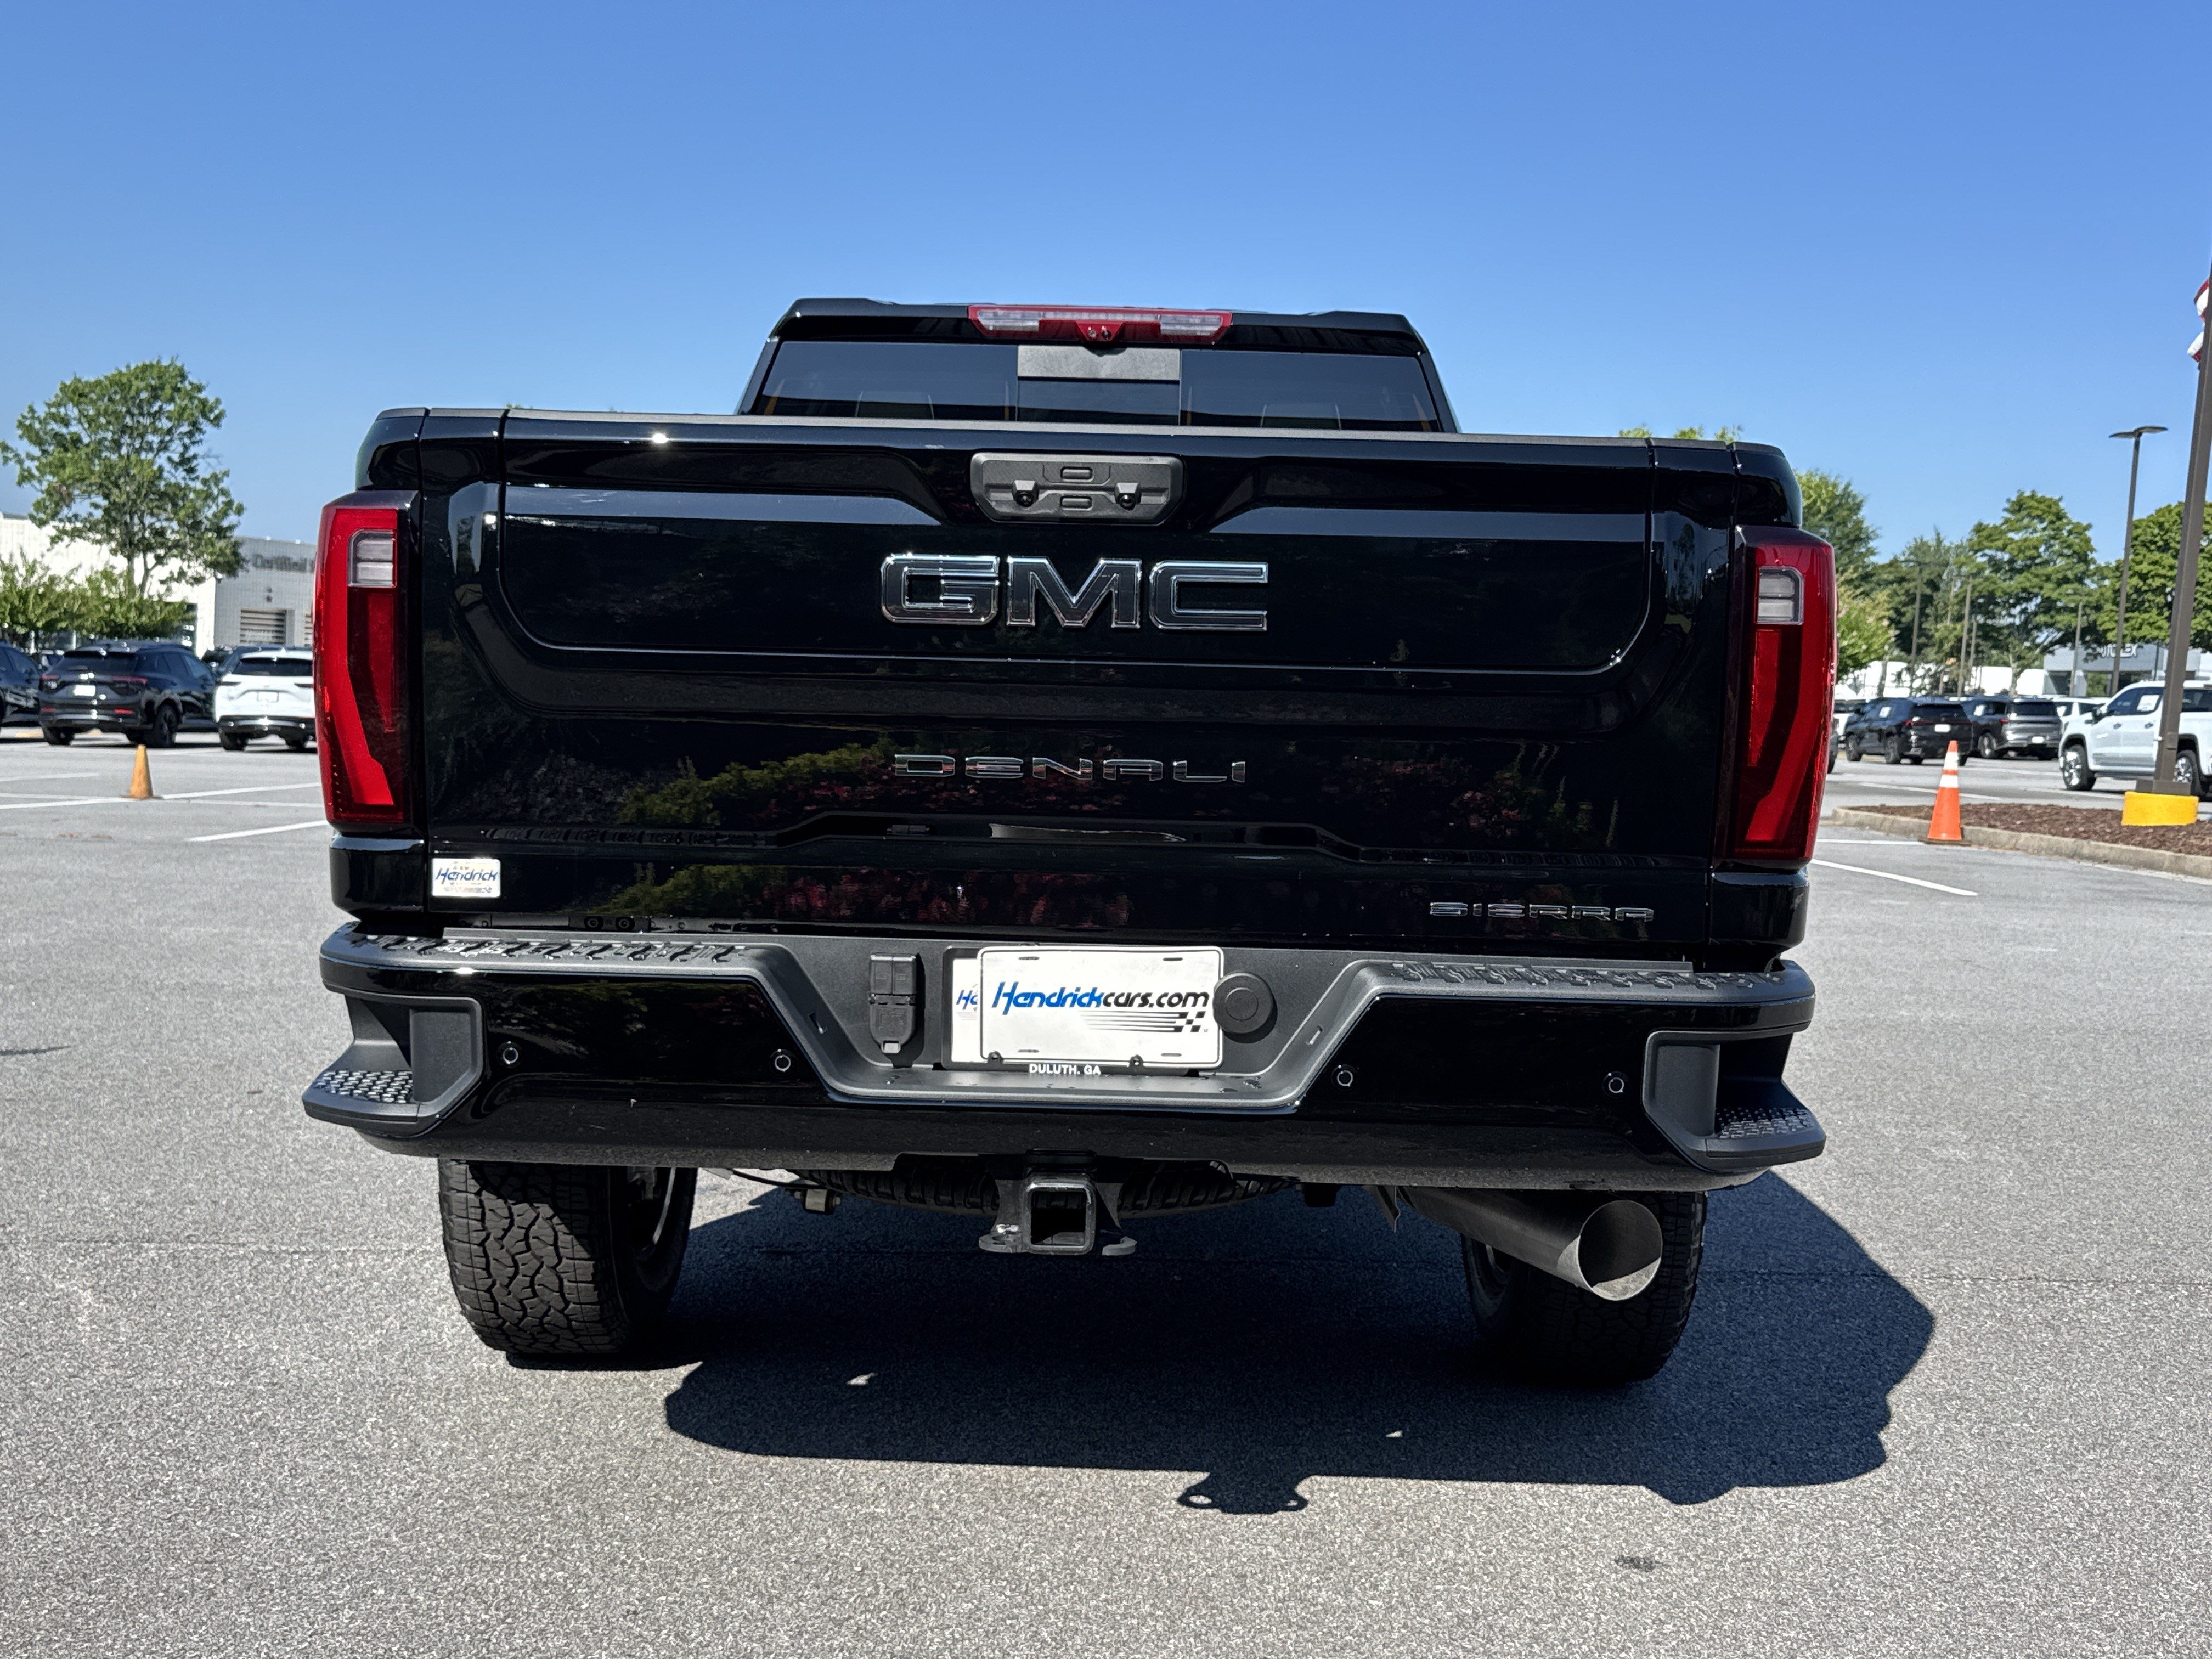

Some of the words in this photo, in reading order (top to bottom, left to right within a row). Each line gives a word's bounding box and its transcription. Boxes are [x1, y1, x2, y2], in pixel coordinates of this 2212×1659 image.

[881, 554, 1269, 631] GMC
[894, 754, 1246, 783] DENALI
[436, 867, 499, 885] Hendrick
[1430, 902, 1654, 922] SIERRA
[992, 981, 1210, 1015] Hendrickcars.com
[1083, 1064, 1101, 1075] GA
